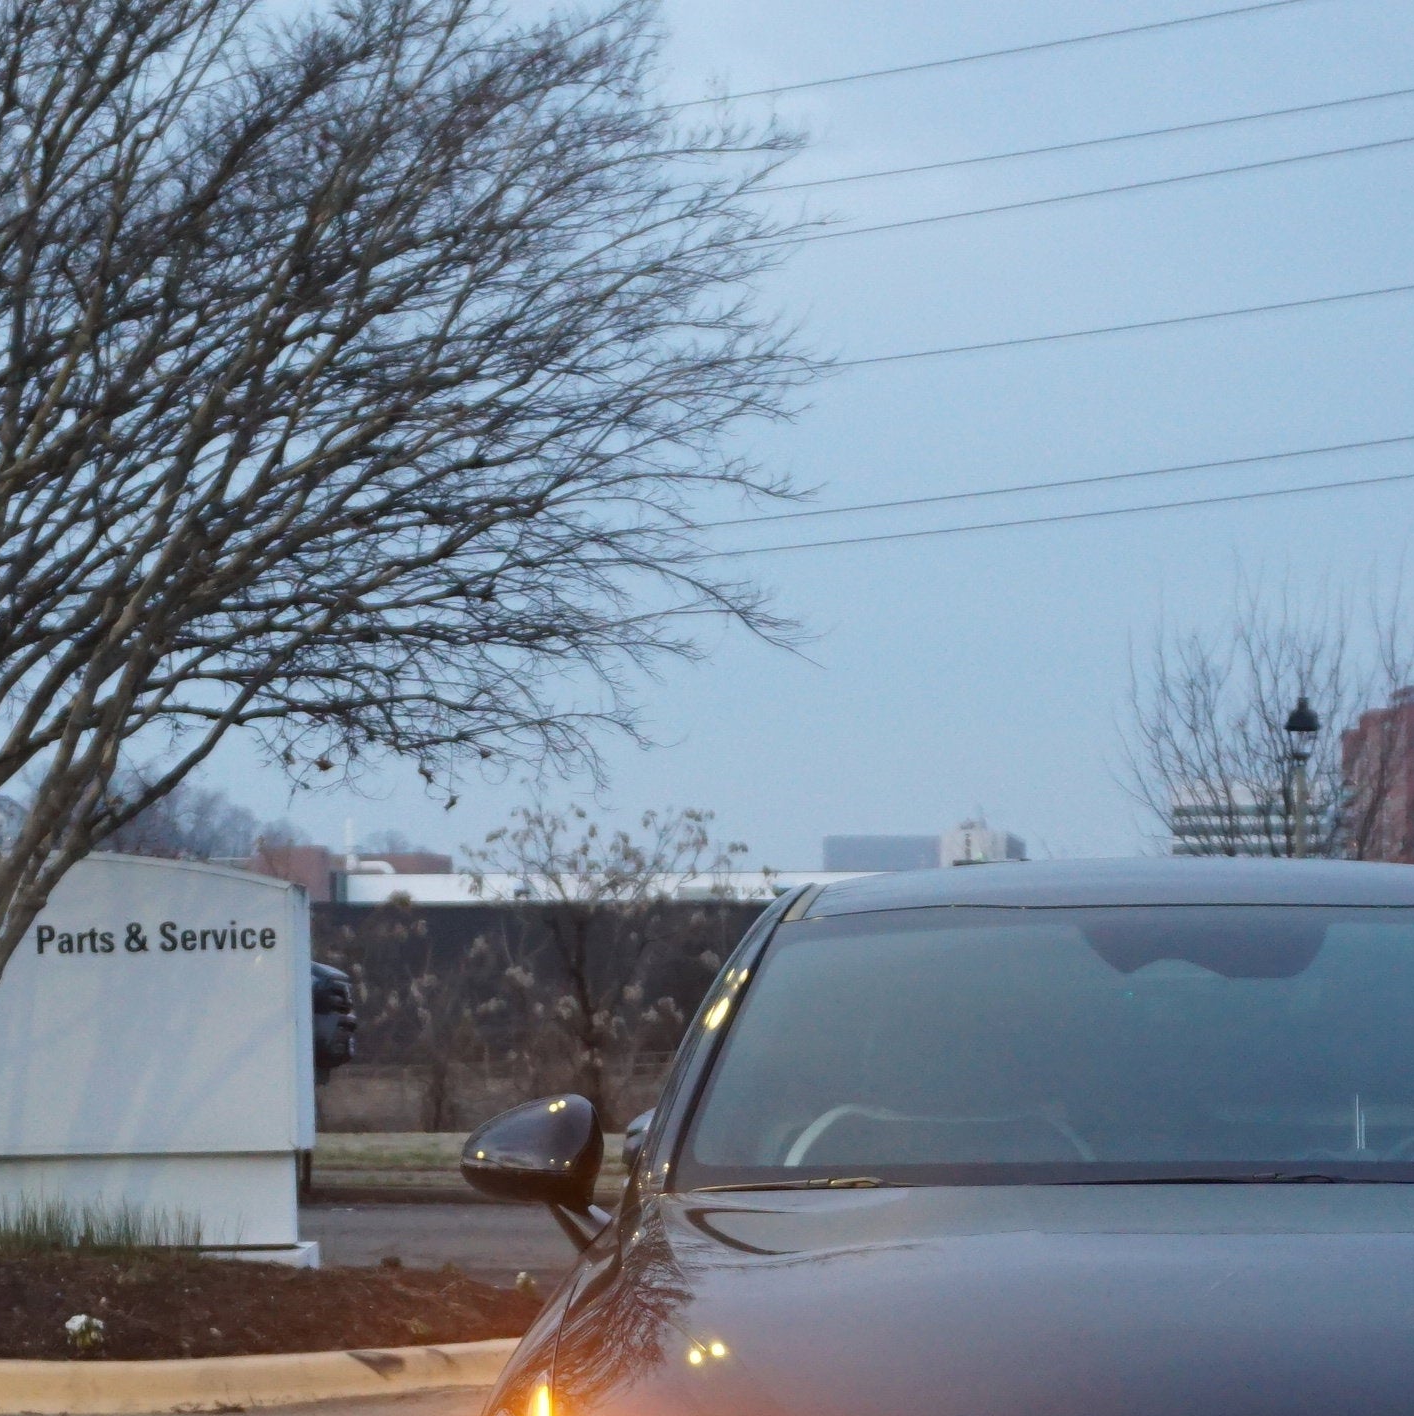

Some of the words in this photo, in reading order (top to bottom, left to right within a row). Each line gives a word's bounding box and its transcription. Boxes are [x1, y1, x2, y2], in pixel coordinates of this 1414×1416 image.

[36, 924, 115, 955] Parts
[124, 922, 148, 953] &
[159, 920, 277, 952] Service
